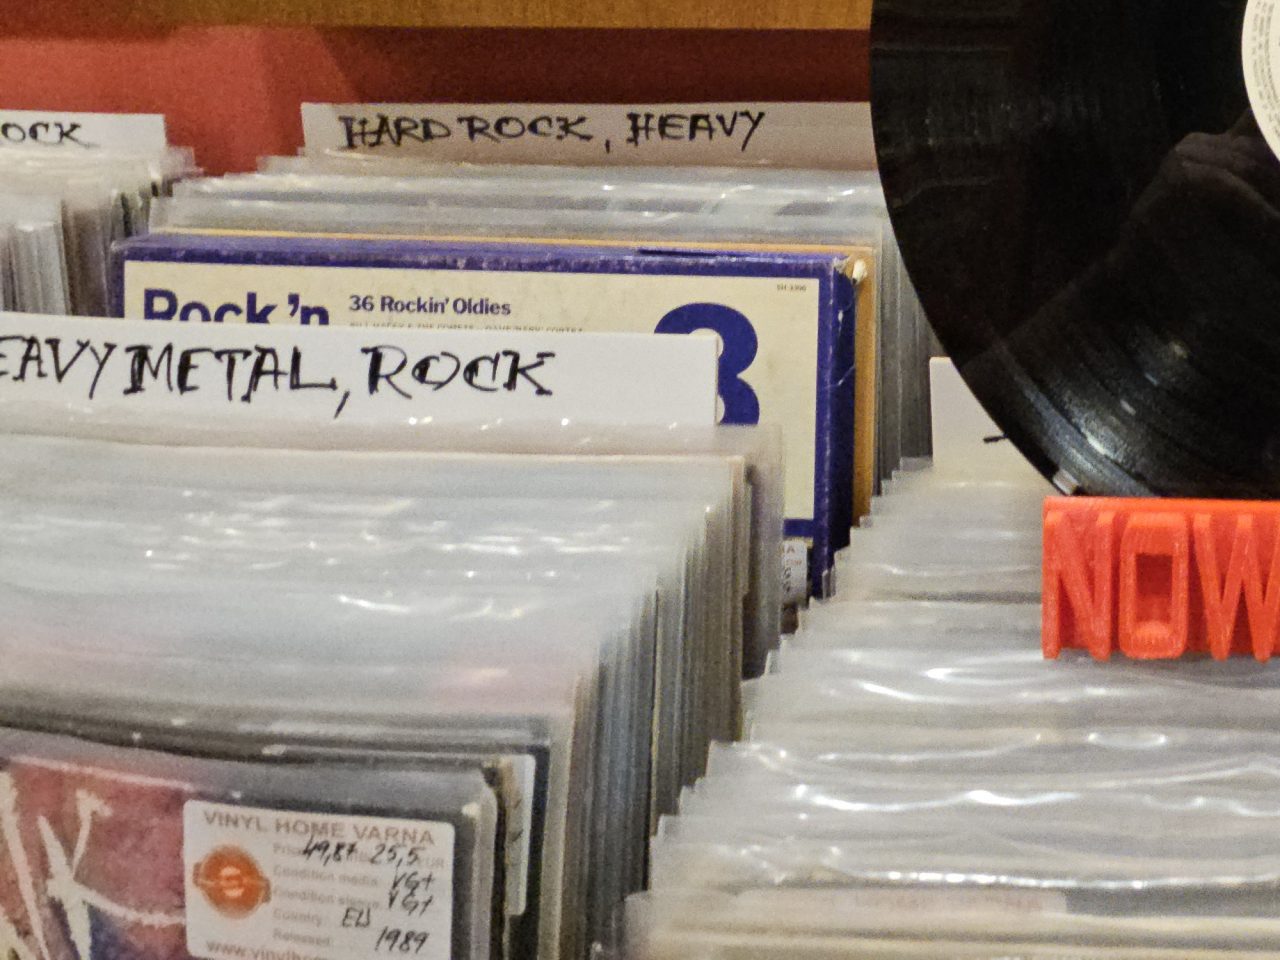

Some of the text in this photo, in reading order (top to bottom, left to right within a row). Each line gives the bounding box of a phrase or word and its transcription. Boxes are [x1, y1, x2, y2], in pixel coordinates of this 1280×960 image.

[1, 121, 100, 150] OCK
[338, 112, 451, 149] HARD
[626, 110, 766, 151] HEAVY
[349, 295, 512, 316] 36 Rockin' Oldies
[360, 345, 555, 399] ROCK
[203, 810, 436, 845] VINYL HOME VARNA
[374, 926, 430, 954] 1989
